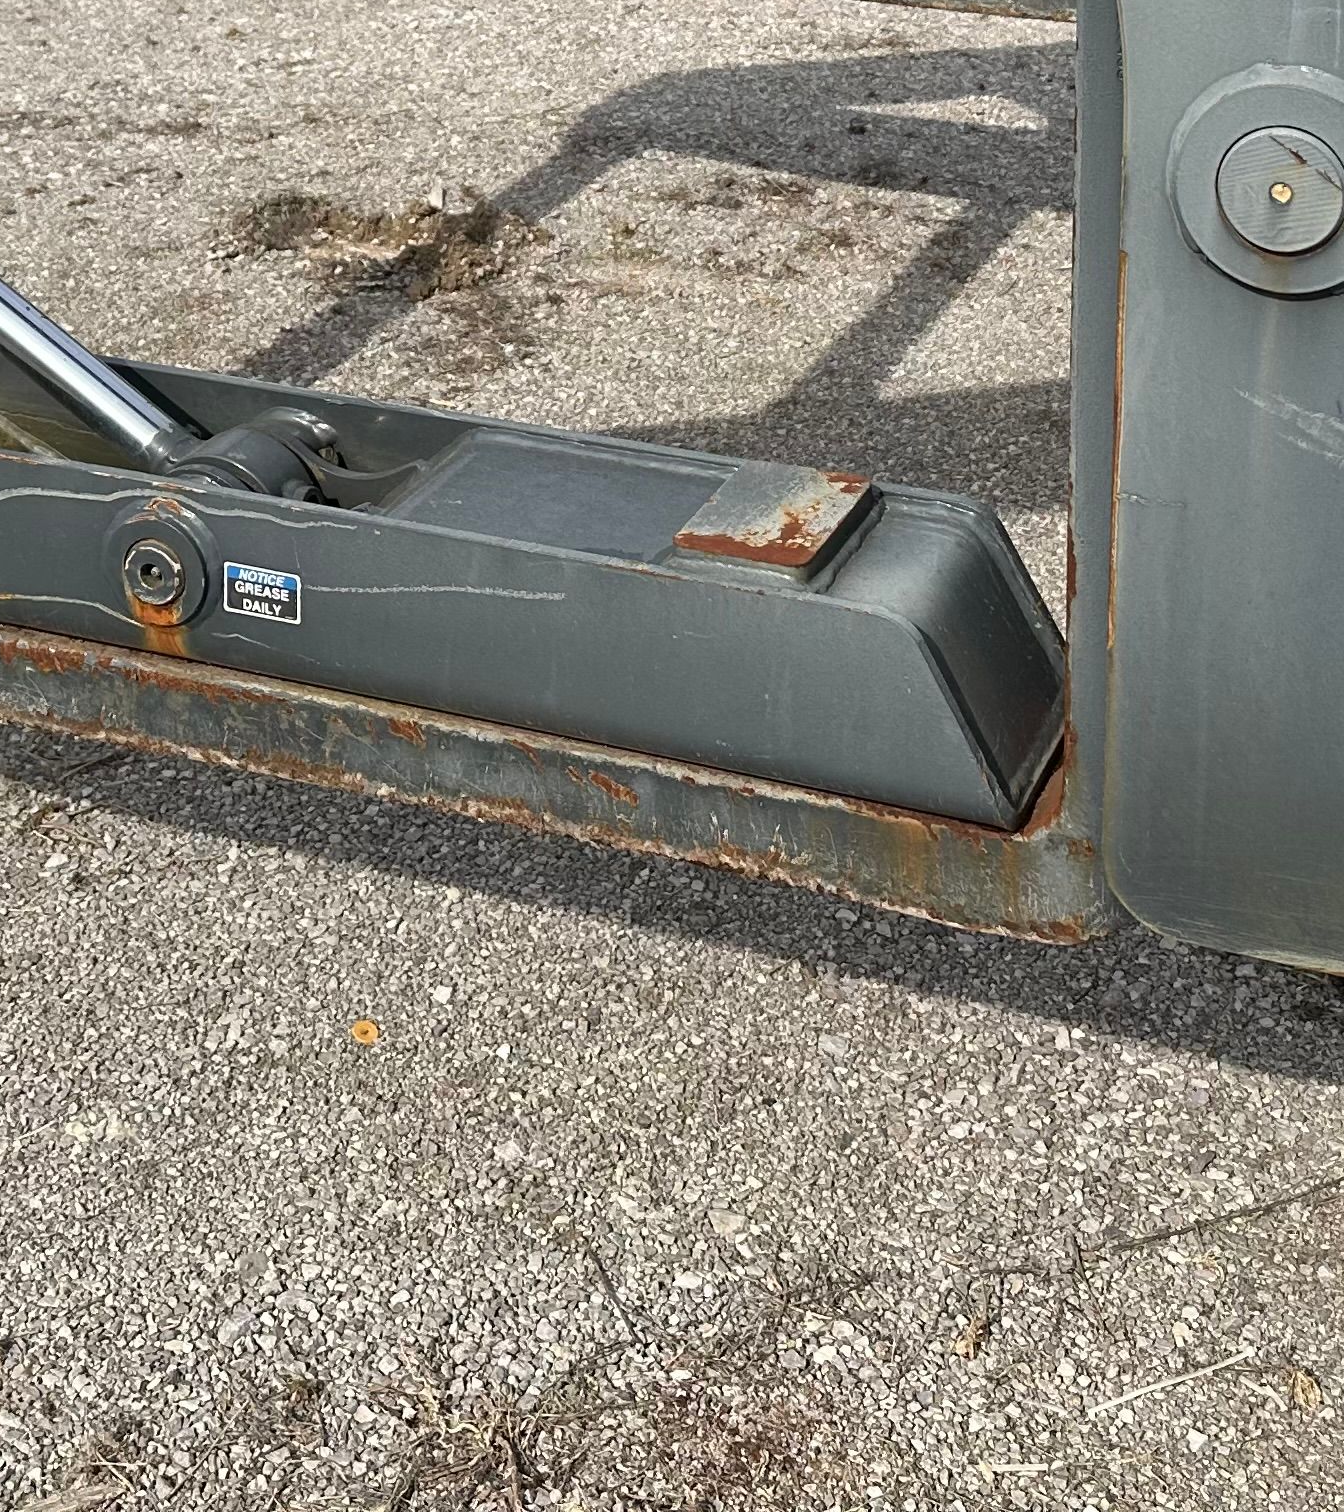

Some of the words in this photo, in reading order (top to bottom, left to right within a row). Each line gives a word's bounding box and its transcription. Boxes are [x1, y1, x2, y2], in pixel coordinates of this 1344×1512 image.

[238, 569, 285, 587] NOTICE
[235, 581, 289, 602] GREASE
[242, 598, 282, 616] DAILY
